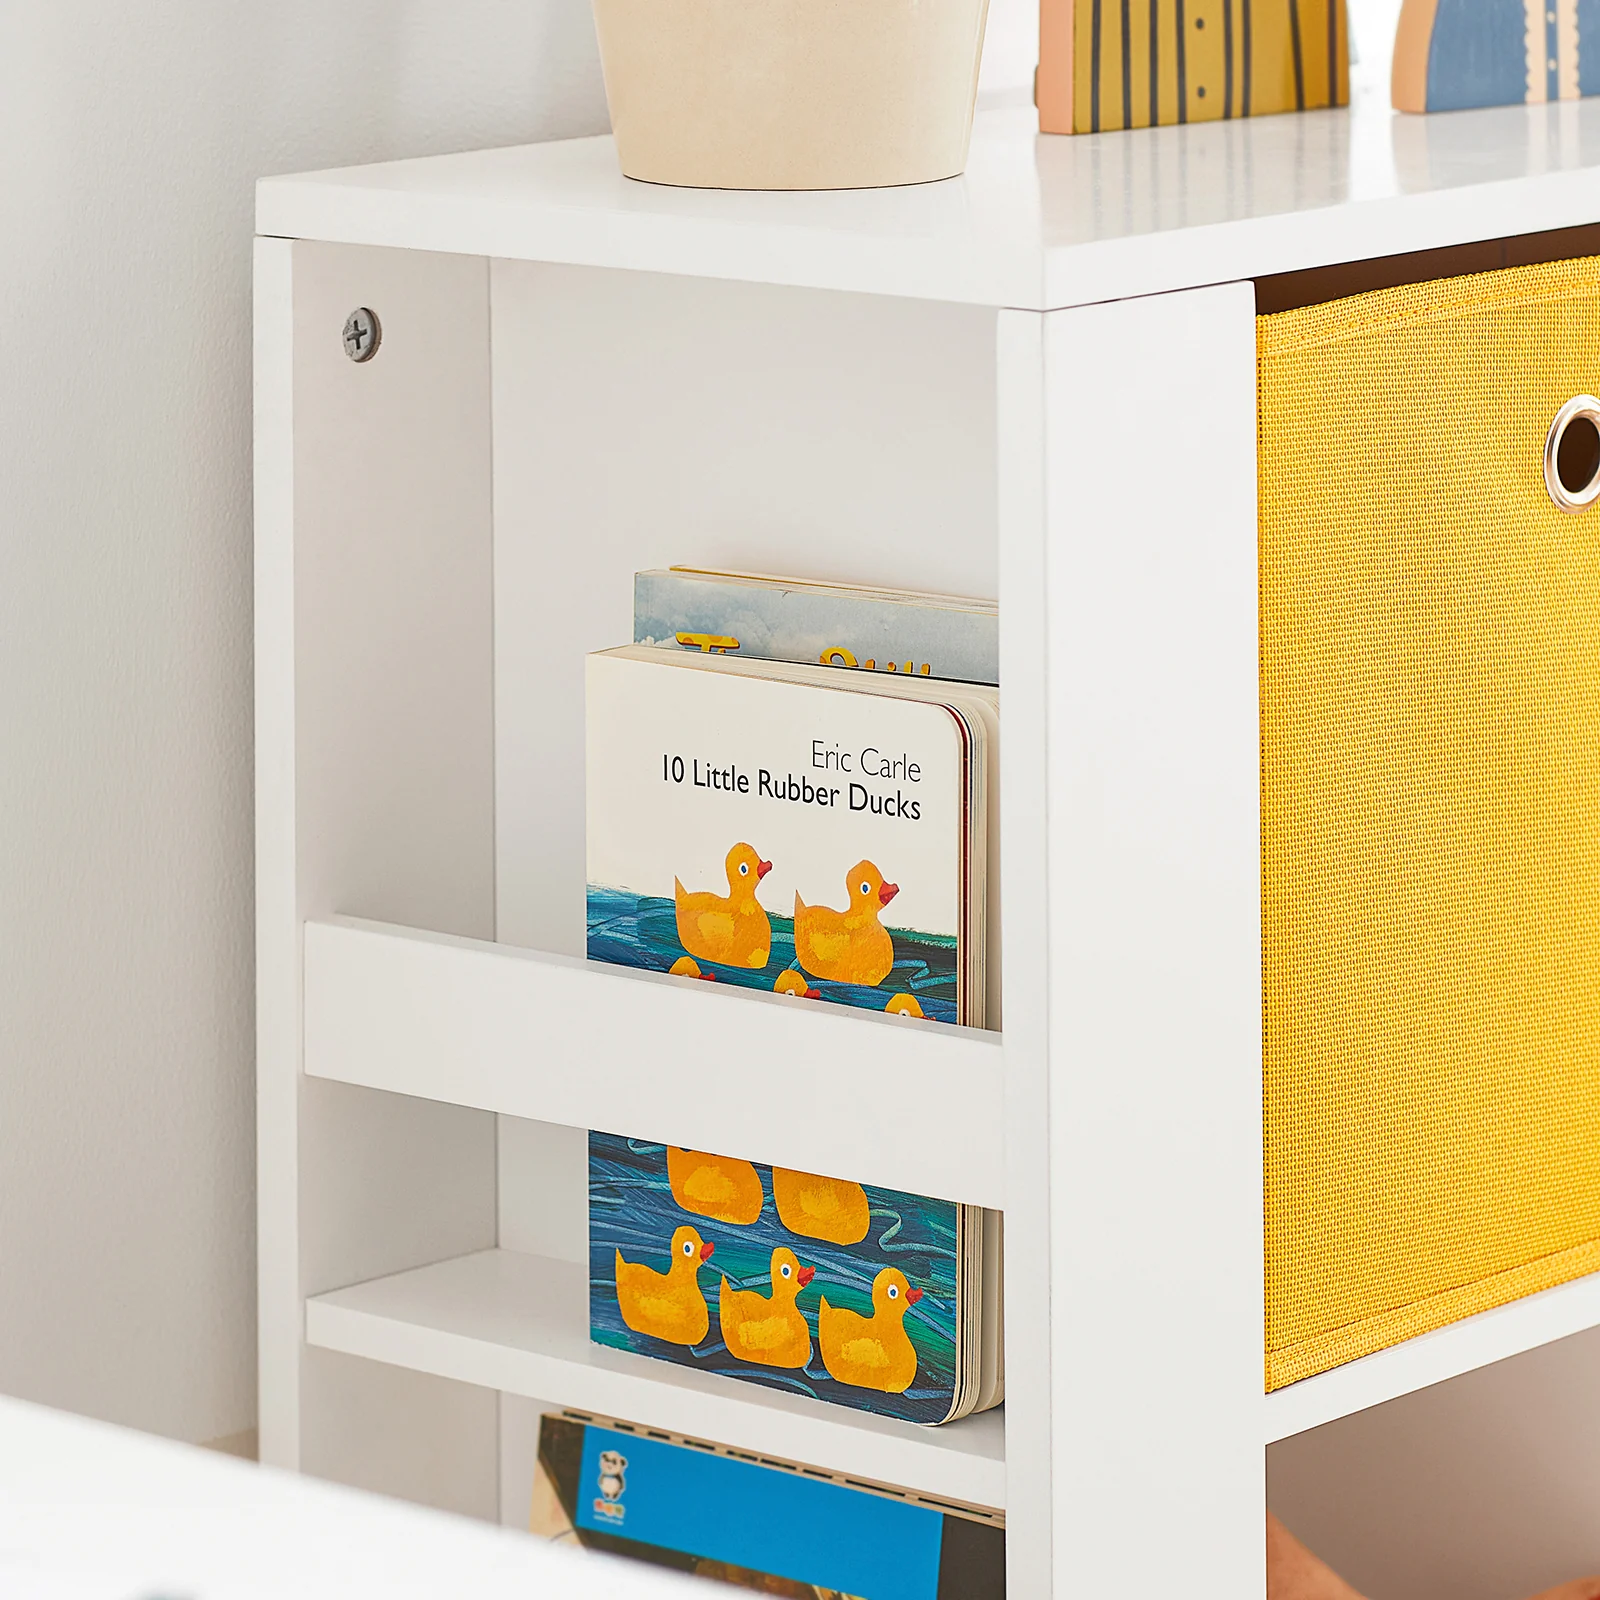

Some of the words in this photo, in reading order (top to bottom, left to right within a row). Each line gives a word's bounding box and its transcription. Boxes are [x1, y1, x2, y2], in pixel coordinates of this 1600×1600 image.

[663, 754, 685, 784] 10
[693, 758, 750, 794] Little
[758, 768, 841, 808] Rubber
[849, 782, 921, 821] Ducks
[812, 739, 852, 773] Eric
[860, 747, 921, 783] Carle
